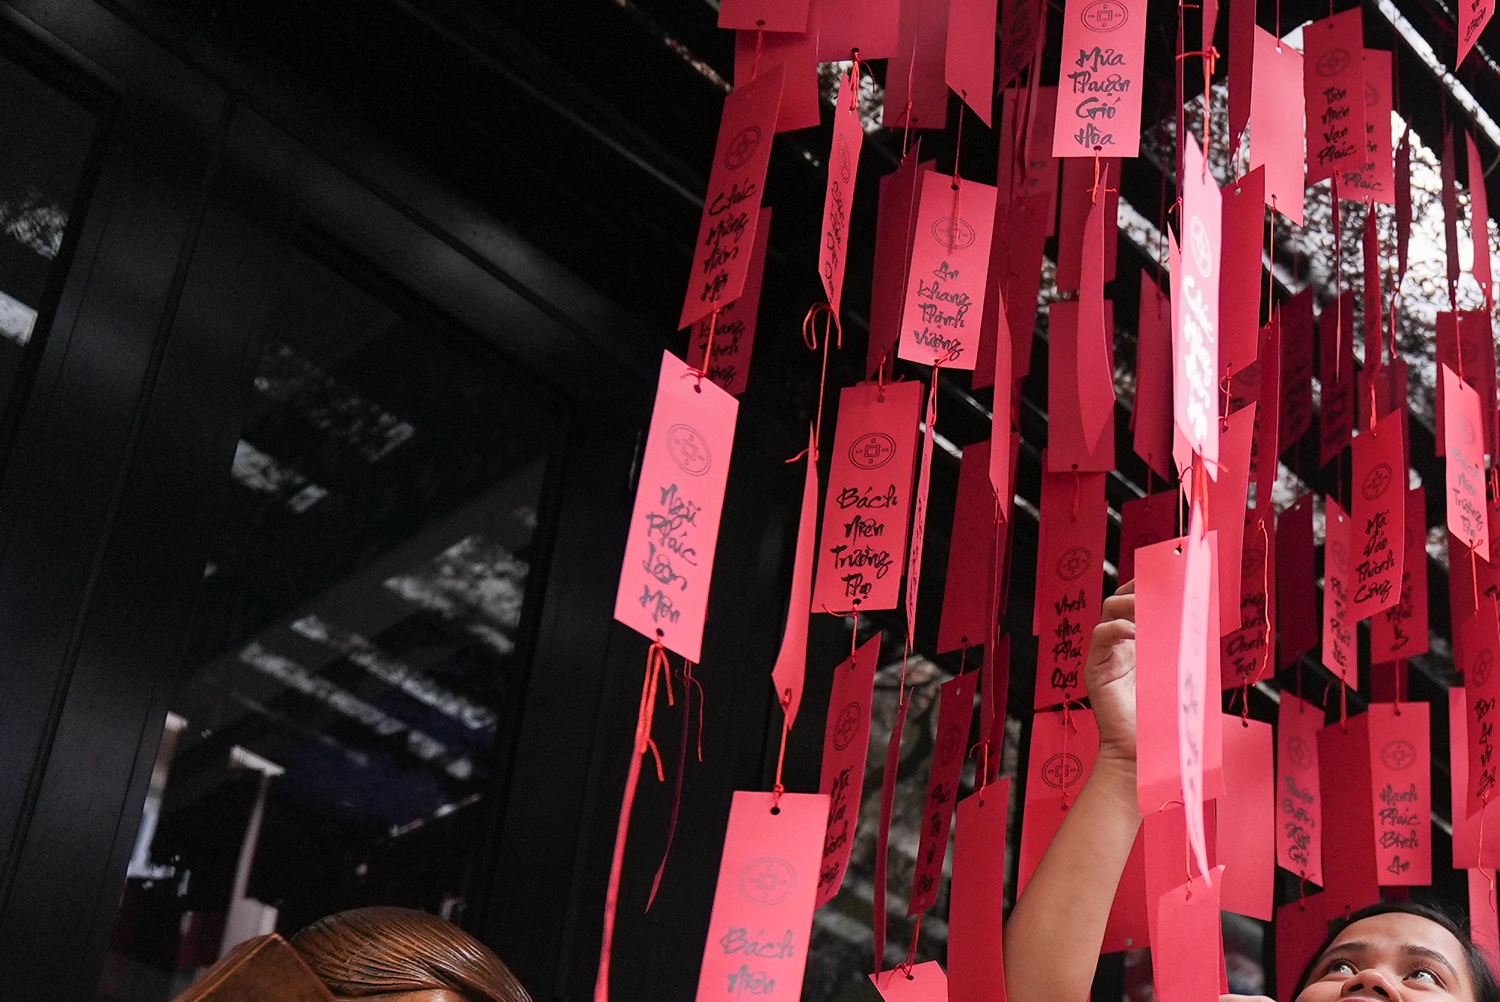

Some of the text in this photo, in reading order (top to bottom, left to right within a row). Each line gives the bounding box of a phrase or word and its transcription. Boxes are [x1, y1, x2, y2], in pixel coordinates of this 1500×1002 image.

[1076, 47, 1126, 72] Mưa
[1067, 71, 1131, 96] Thuận
[1076, 97, 1121, 120] Gió
[933, 261, 959, 281] An
[836, 484, 898, 509] Bách
[844, 515, 884, 545] Niên
[830, 545, 893, 579] Trường
[841, 573, 872, 599] Thọ
[720, 928, 794, 958] Bách
